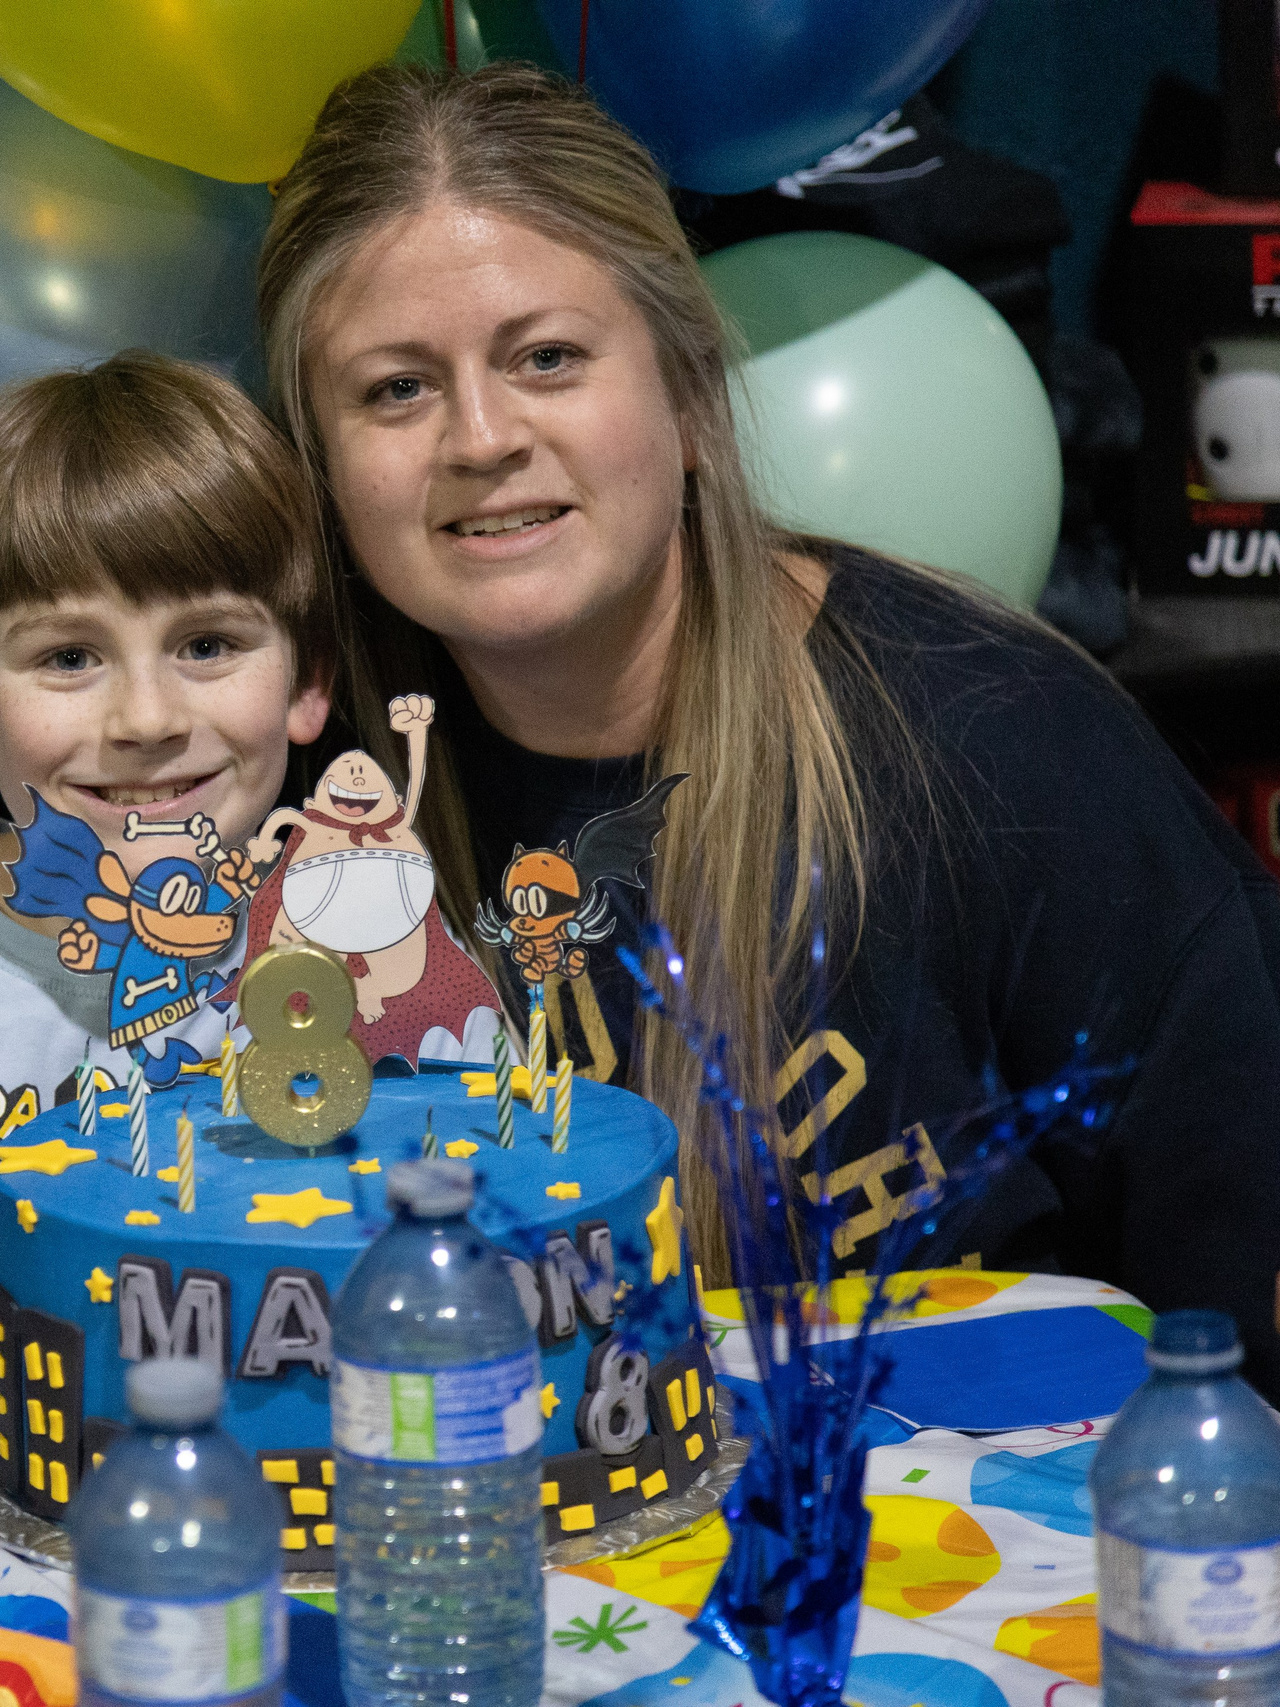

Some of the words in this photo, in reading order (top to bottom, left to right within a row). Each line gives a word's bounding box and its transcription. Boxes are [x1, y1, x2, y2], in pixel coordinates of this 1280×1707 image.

[237, 941, 373, 1147] 8
[118, 1218, 616, 1382] MAN
[578, 1336, 650, 1457] 8
